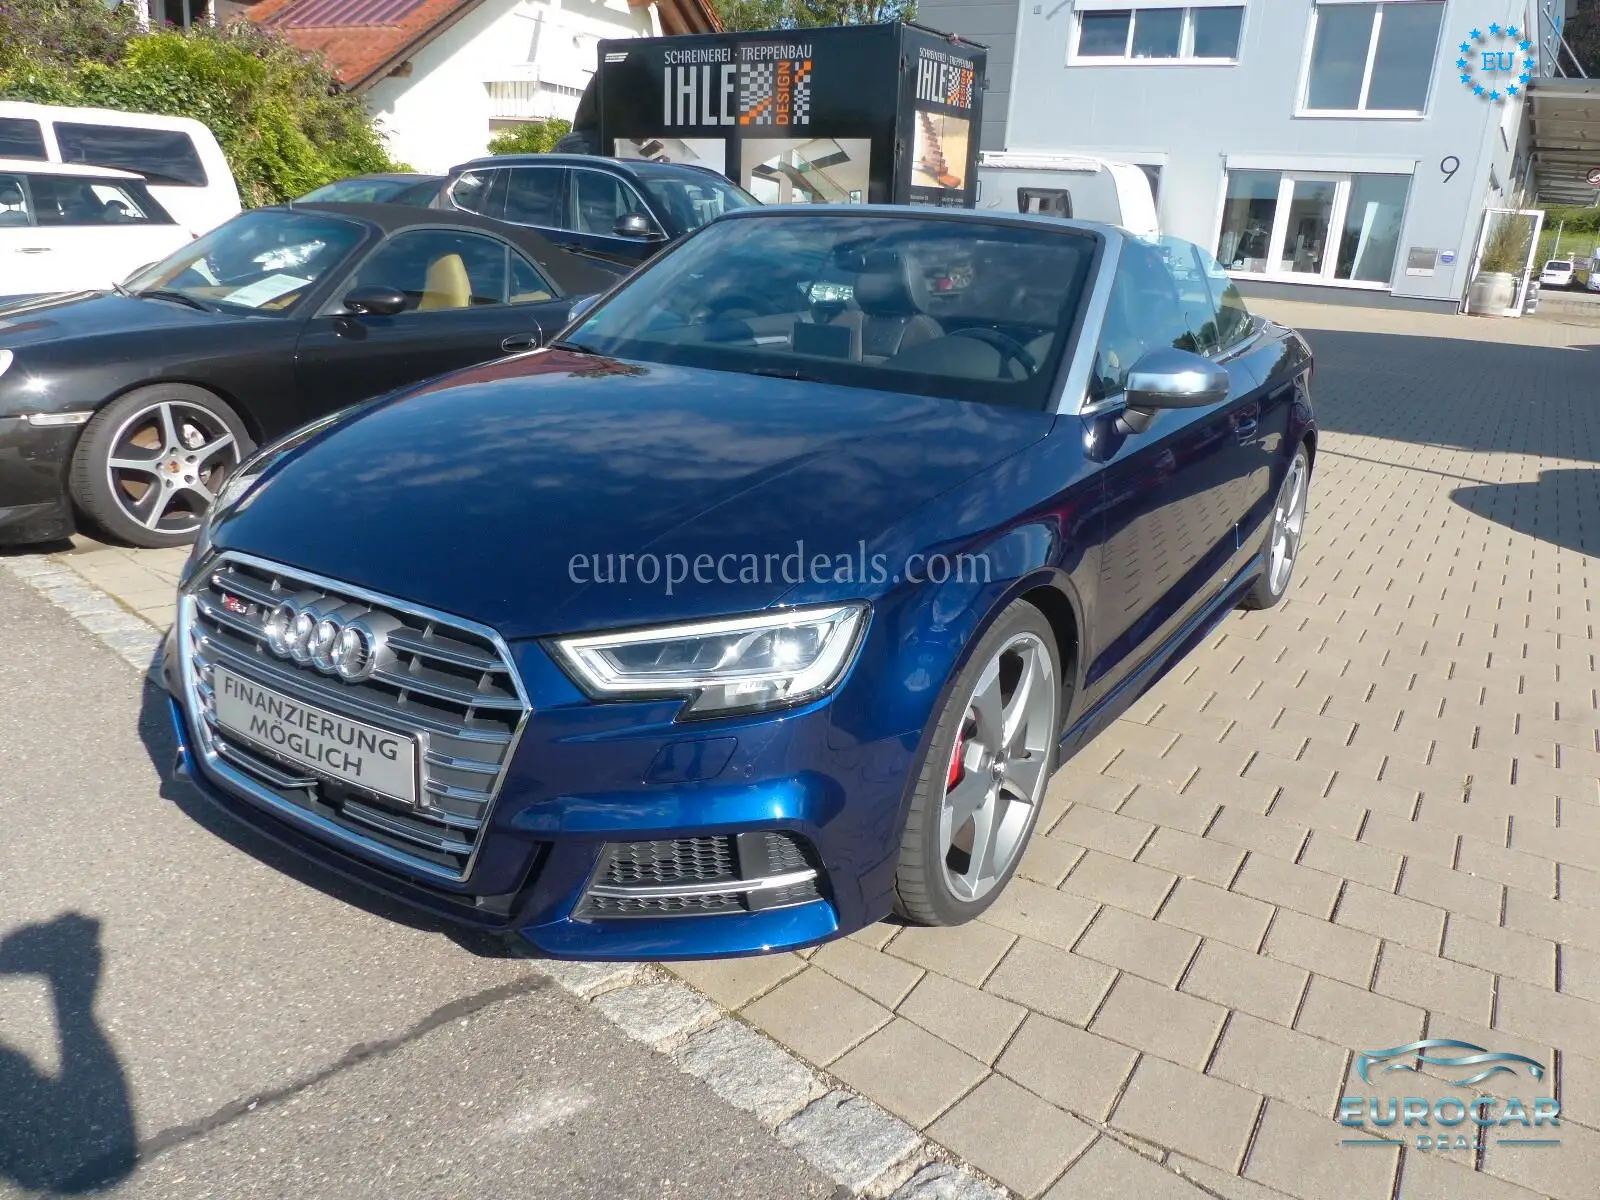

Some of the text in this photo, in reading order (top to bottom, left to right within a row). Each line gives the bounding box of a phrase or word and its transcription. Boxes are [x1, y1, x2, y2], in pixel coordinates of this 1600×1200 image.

[664, 44, 812, 64] SCHREINEREI TREPPENBAU
[916, 57, 947, 104] IHLE
[664, 64, 737, 126] IHLE
[776, 61, 791, 125] DESIGN
[1440, 155, 1460, 184] 9
[224, 676, 399, 761] FINANZIERUNG
[250, 715, 363, 777] MÖGLICH
